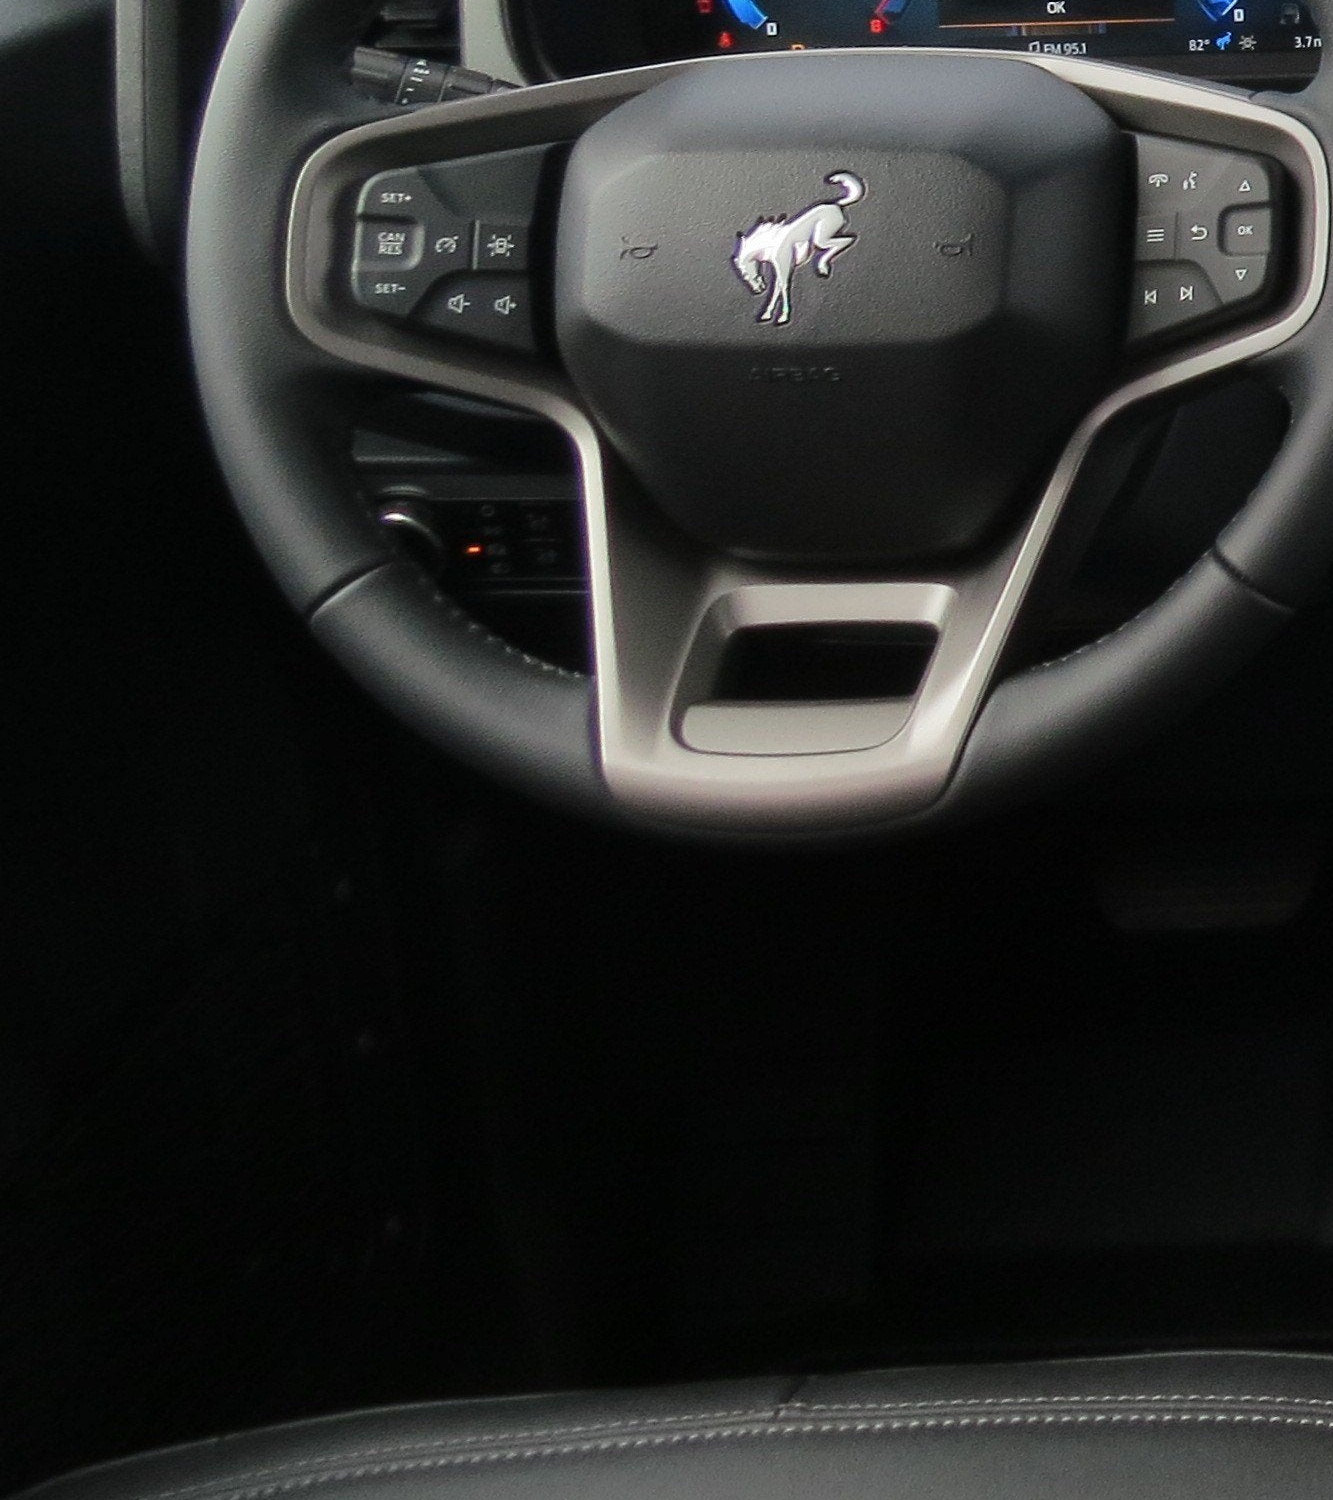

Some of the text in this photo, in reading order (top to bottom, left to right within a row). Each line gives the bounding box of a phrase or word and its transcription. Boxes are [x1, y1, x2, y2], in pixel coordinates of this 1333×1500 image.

[1046, 1, 1066, 14] OK
[1233, 9, 1244, 22] 0
[766, 22, 778, 36] 0
[869, 19, 881, 34] 8
[1063, 42, 1087, 54] 95.1
[1188, 38, 1211, 51] 82°
[1237, 225, 1254, 236] OK
[377, 232, 406, 243] CAN
